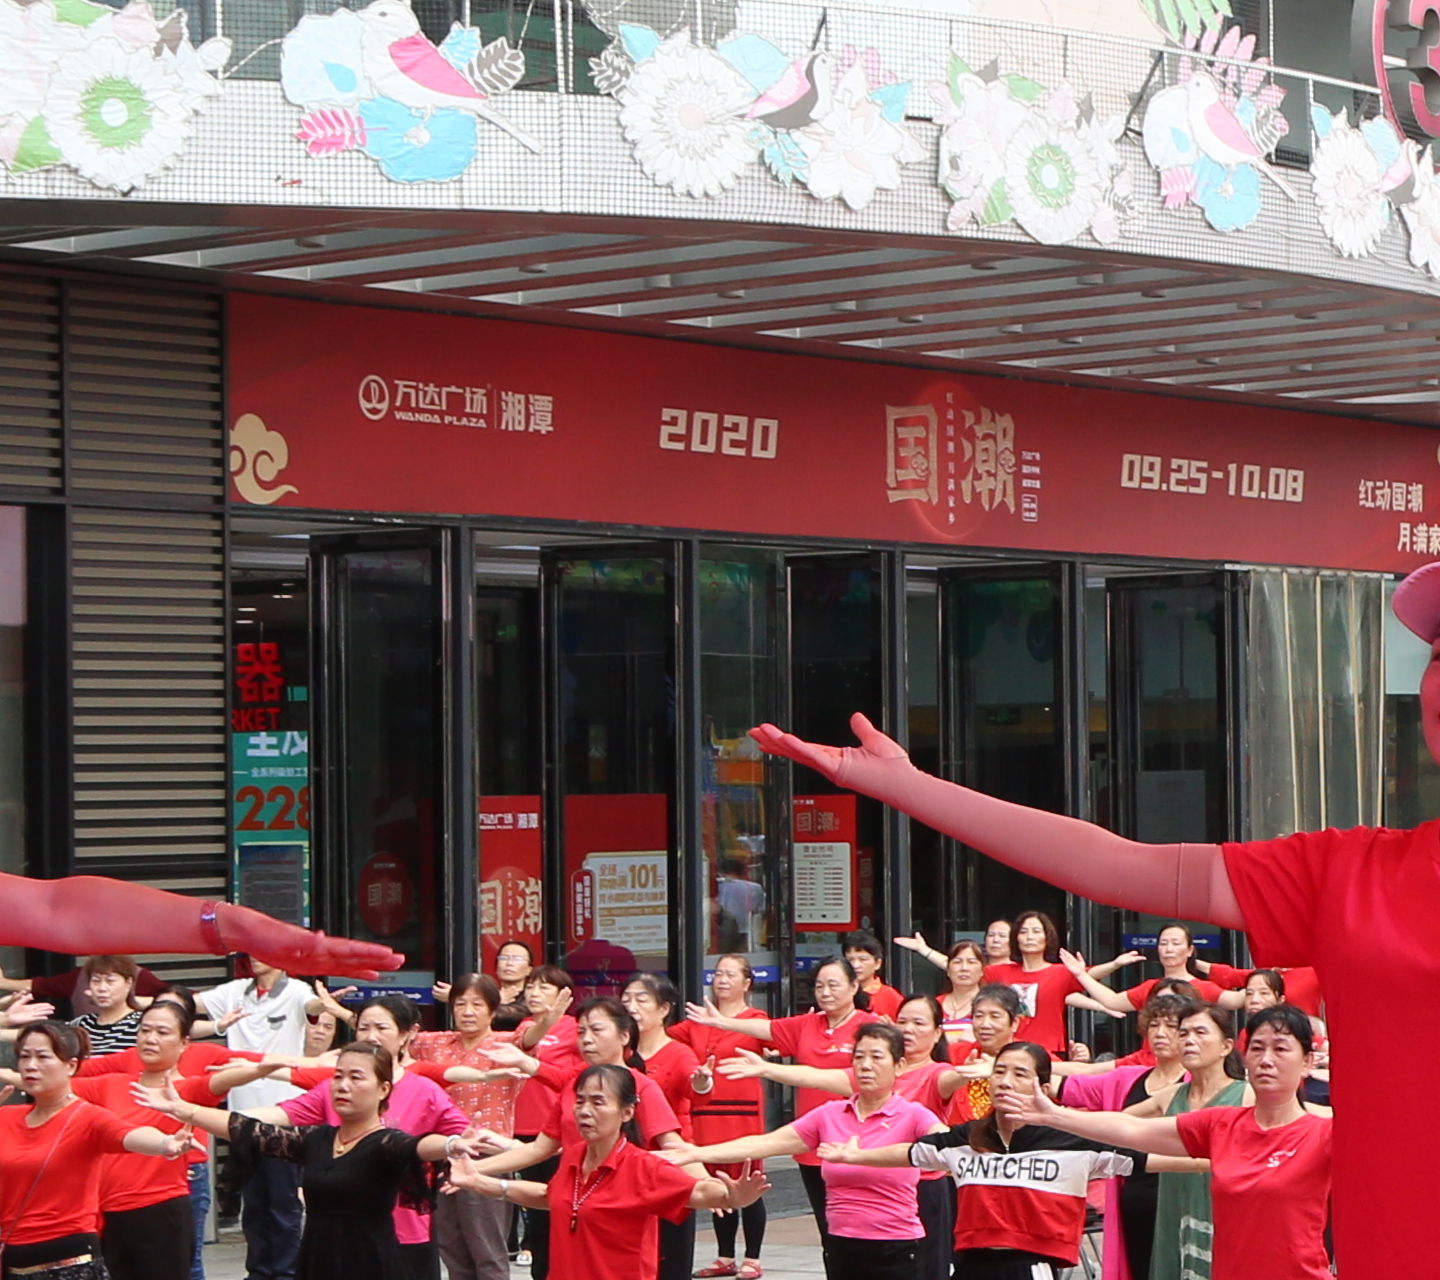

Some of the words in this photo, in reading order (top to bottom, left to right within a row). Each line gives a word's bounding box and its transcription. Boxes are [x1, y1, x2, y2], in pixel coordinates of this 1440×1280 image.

[393, 379, 488, 415] 万达广场
[500, 390, 555, 435] 湘潭
[394, 410, 442, 425] WANDA
[444, 415, 487, 428] PLAZA
[659, 407, 779, 459] 2020
[885, 403, 1017, 515] 国潮
[1120, 453, 1305, 503] 09.25-10.08
[1358, 478, 1424, 513] 红动国潮
[235, 642, 284, 703] 器
[956, 1155, 1060, 1182] SANTCHED
